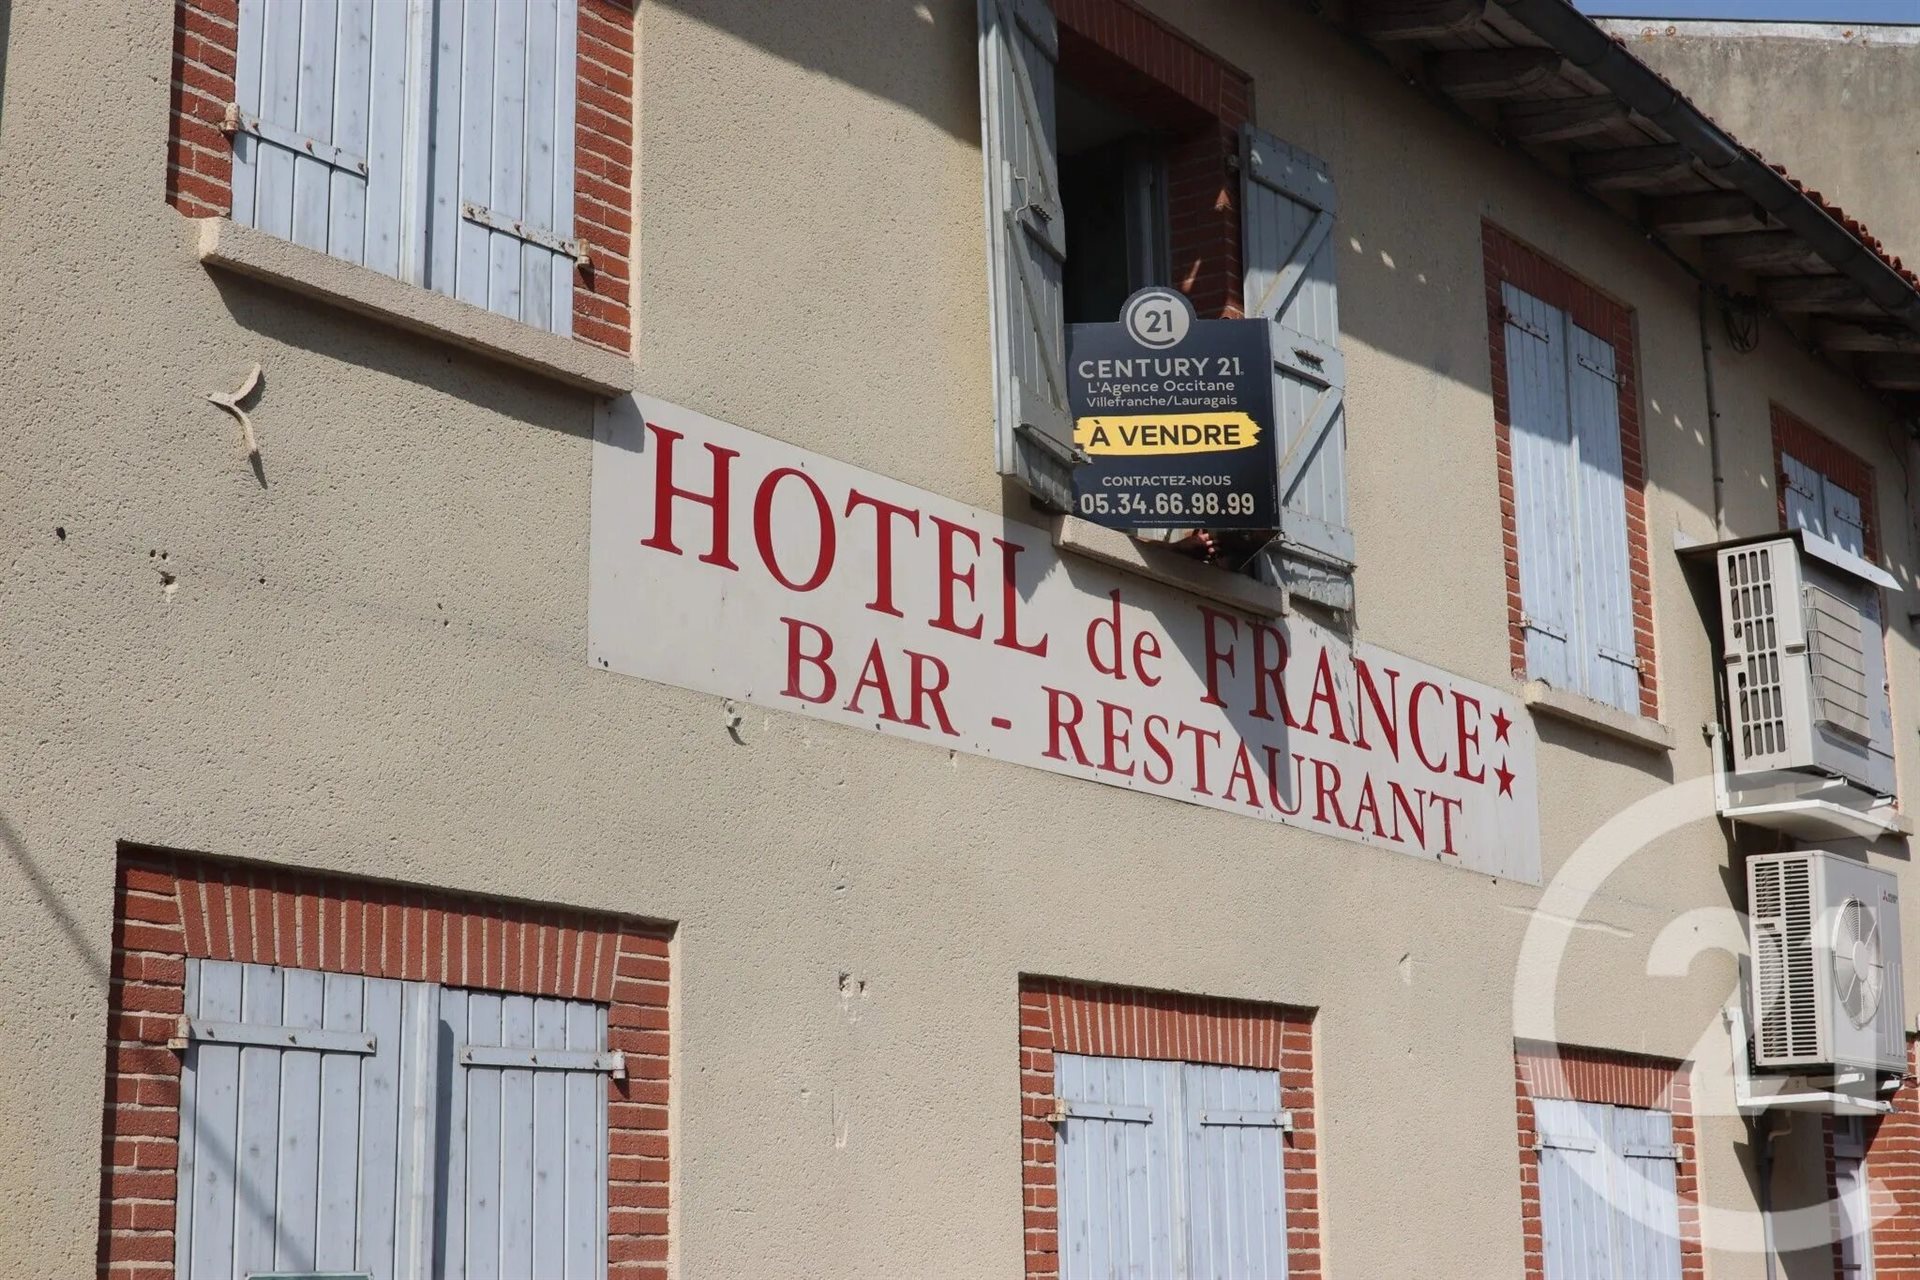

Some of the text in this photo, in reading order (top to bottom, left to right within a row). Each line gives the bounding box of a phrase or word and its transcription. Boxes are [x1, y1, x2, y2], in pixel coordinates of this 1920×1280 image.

[1144, 309, 1173, 333] 21
[1078, 357, 1240, 379] CENTURY 21
[1087, 380, 1235, 397] L'Agence Occitane
[1086, 394, 1238, 409] Villefranche/Lauragais
[1089, 419, 1241, 447] À VENDRE
[1101, 475, 1232, 487] CONTACTEZ-NOUS
[1080, 492, 1255, 516] 05.34.66.98.99
[640, 422, 1486, 784] HOTEL de FRANCE
[779, 616, 961, 737] BAR
[1041, 685, 1463, 857] RESTAURANT
